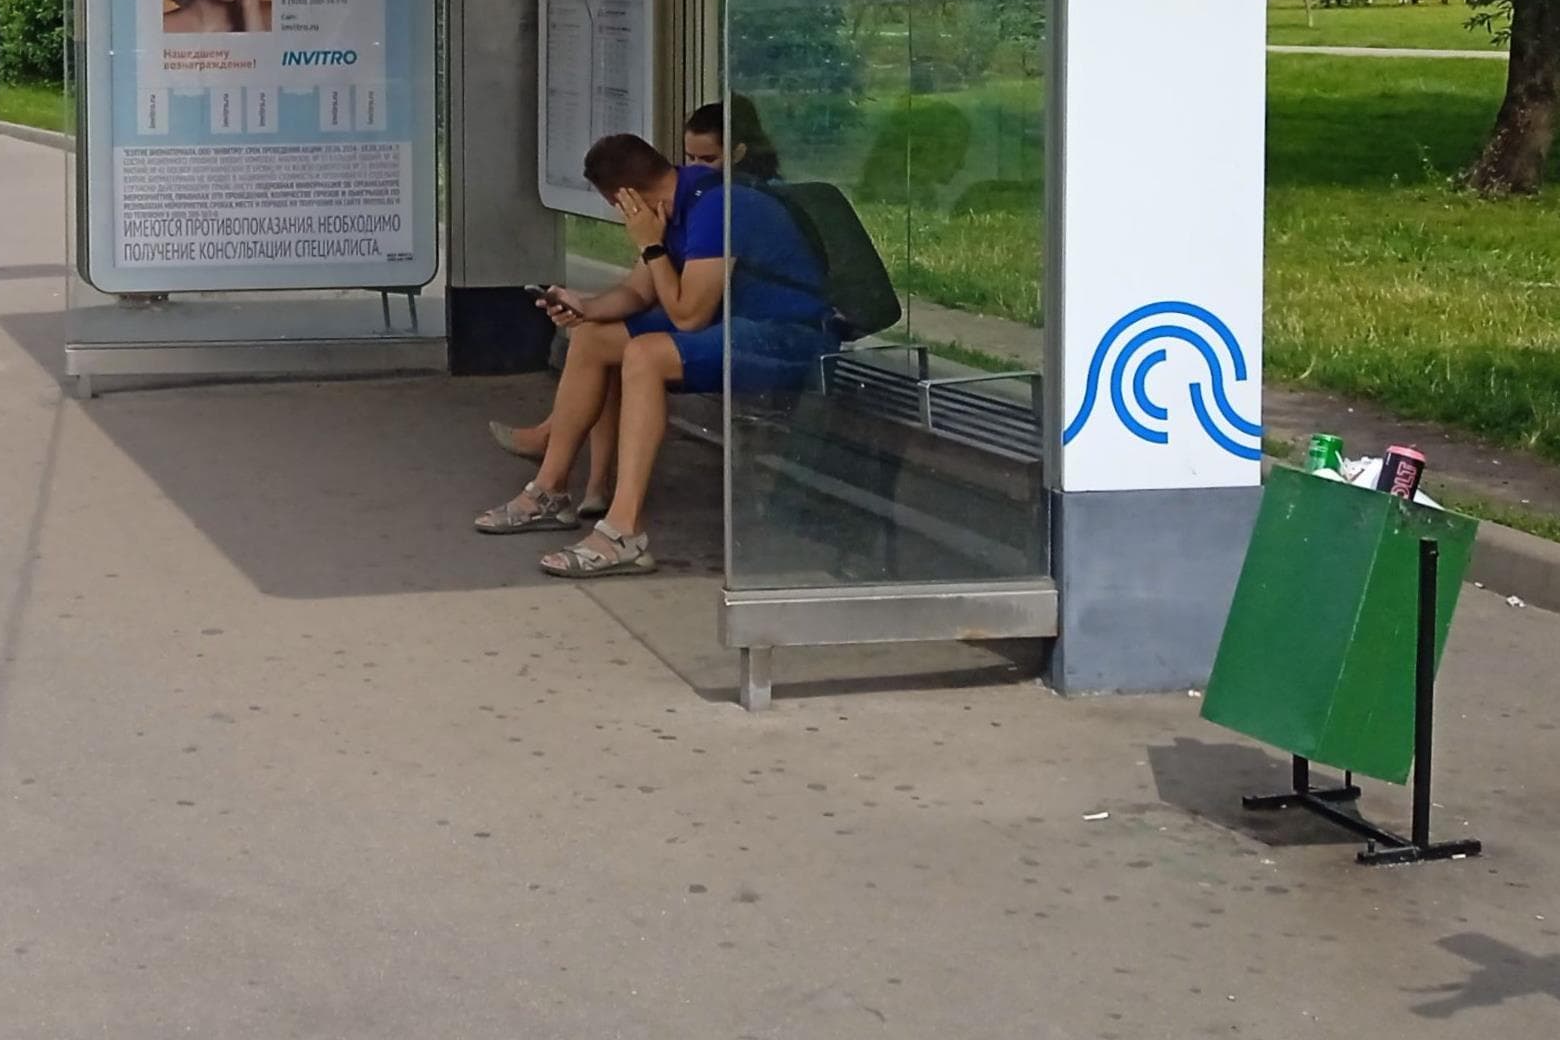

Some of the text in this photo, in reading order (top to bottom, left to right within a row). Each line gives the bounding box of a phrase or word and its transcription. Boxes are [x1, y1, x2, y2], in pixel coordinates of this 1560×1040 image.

[281, 50, 358, 66] INVITRO
[123, 218, 183, 238] ИМЕЮТСЯ
[317, 213, 401, 235] НЕОБХОДИМО
[123, 241, 197, 262] ПОЛУЧЕНИЕ
[199, 240, 293, 261] КОНСУЛЬТАЦИИ
[295, 238, 383, 259] СПЕЦИАЛИСТА.
